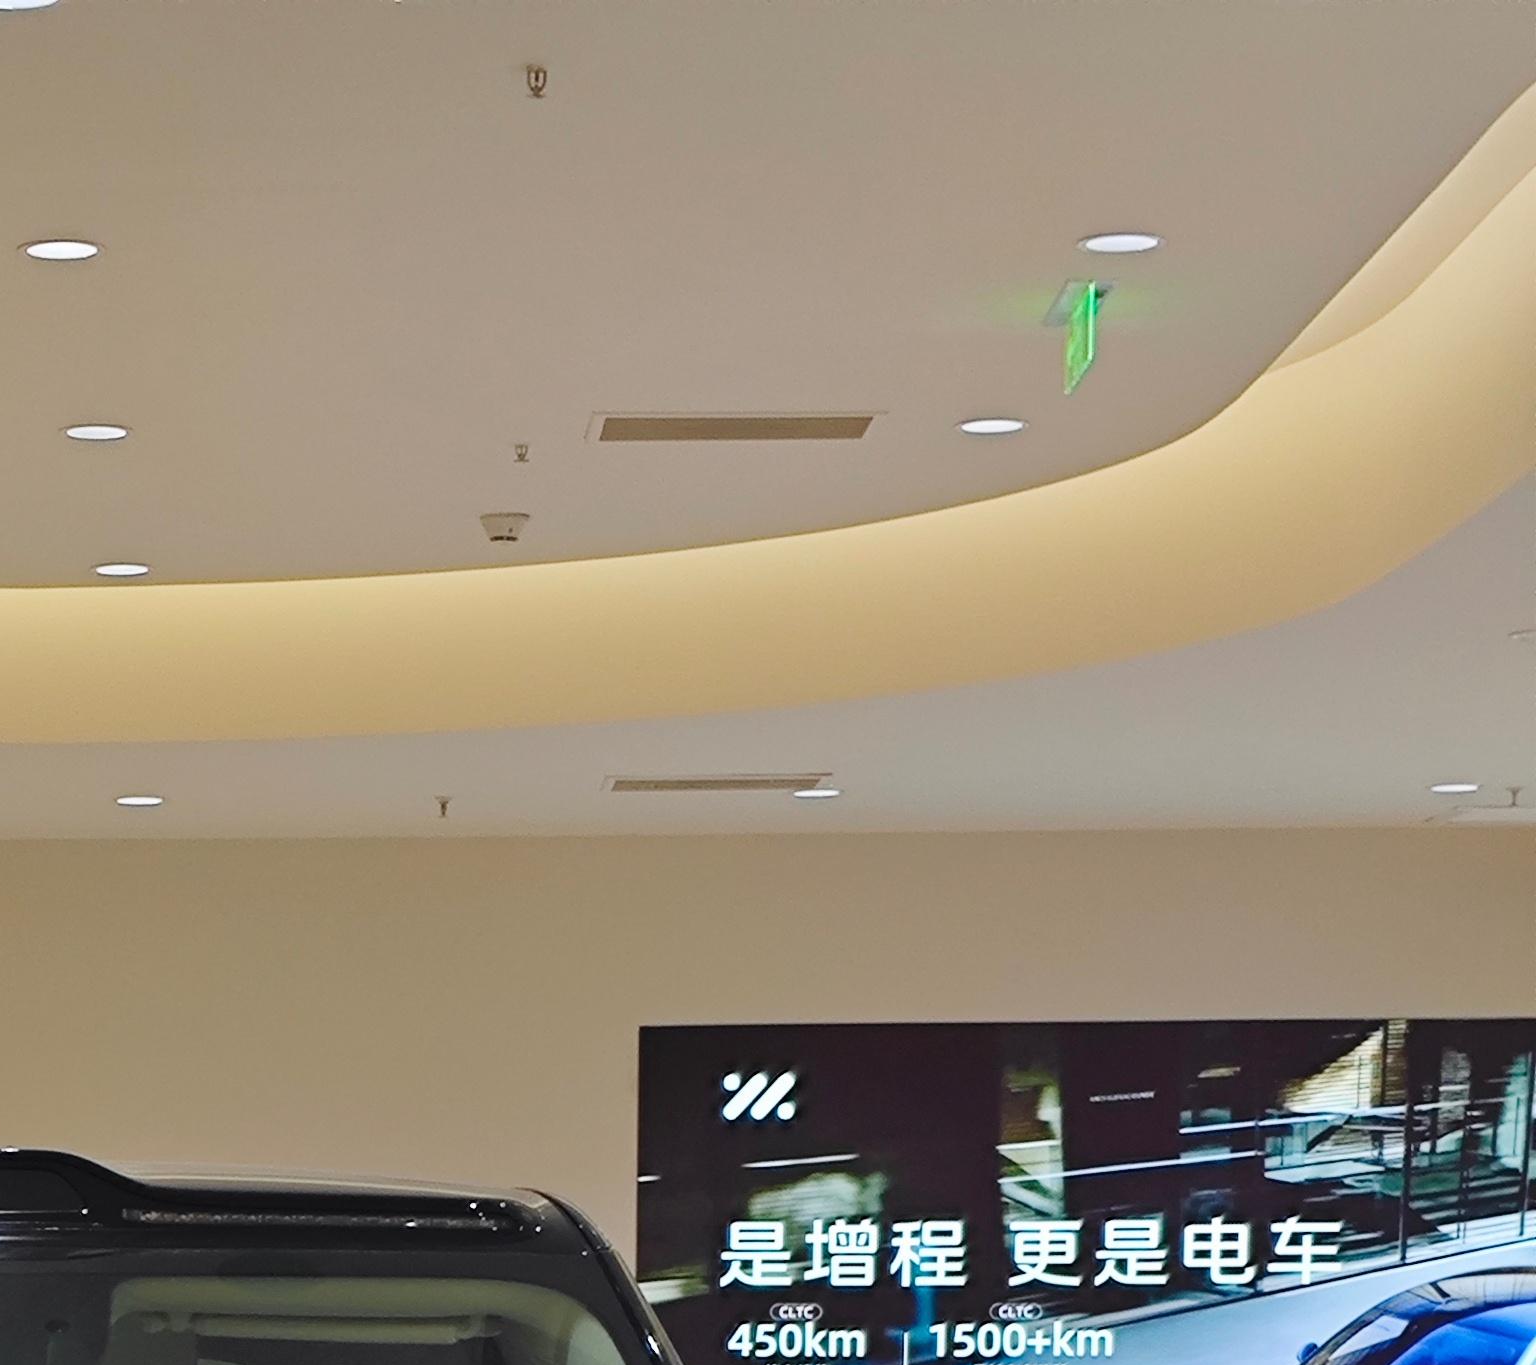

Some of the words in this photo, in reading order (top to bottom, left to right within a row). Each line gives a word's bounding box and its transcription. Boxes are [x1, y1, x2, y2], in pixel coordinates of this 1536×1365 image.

[718, 1217, 969, 1288] 是增程
[1007, 1215, 1345, 1288] 更是电车
[778, 1305, 814, 1319] CLTC
[998, 1305, 1034, 1319] CLTC
[727, 1321, 866, 1358] 450km
[928, 1321, 1114, 1358] 1500+km
